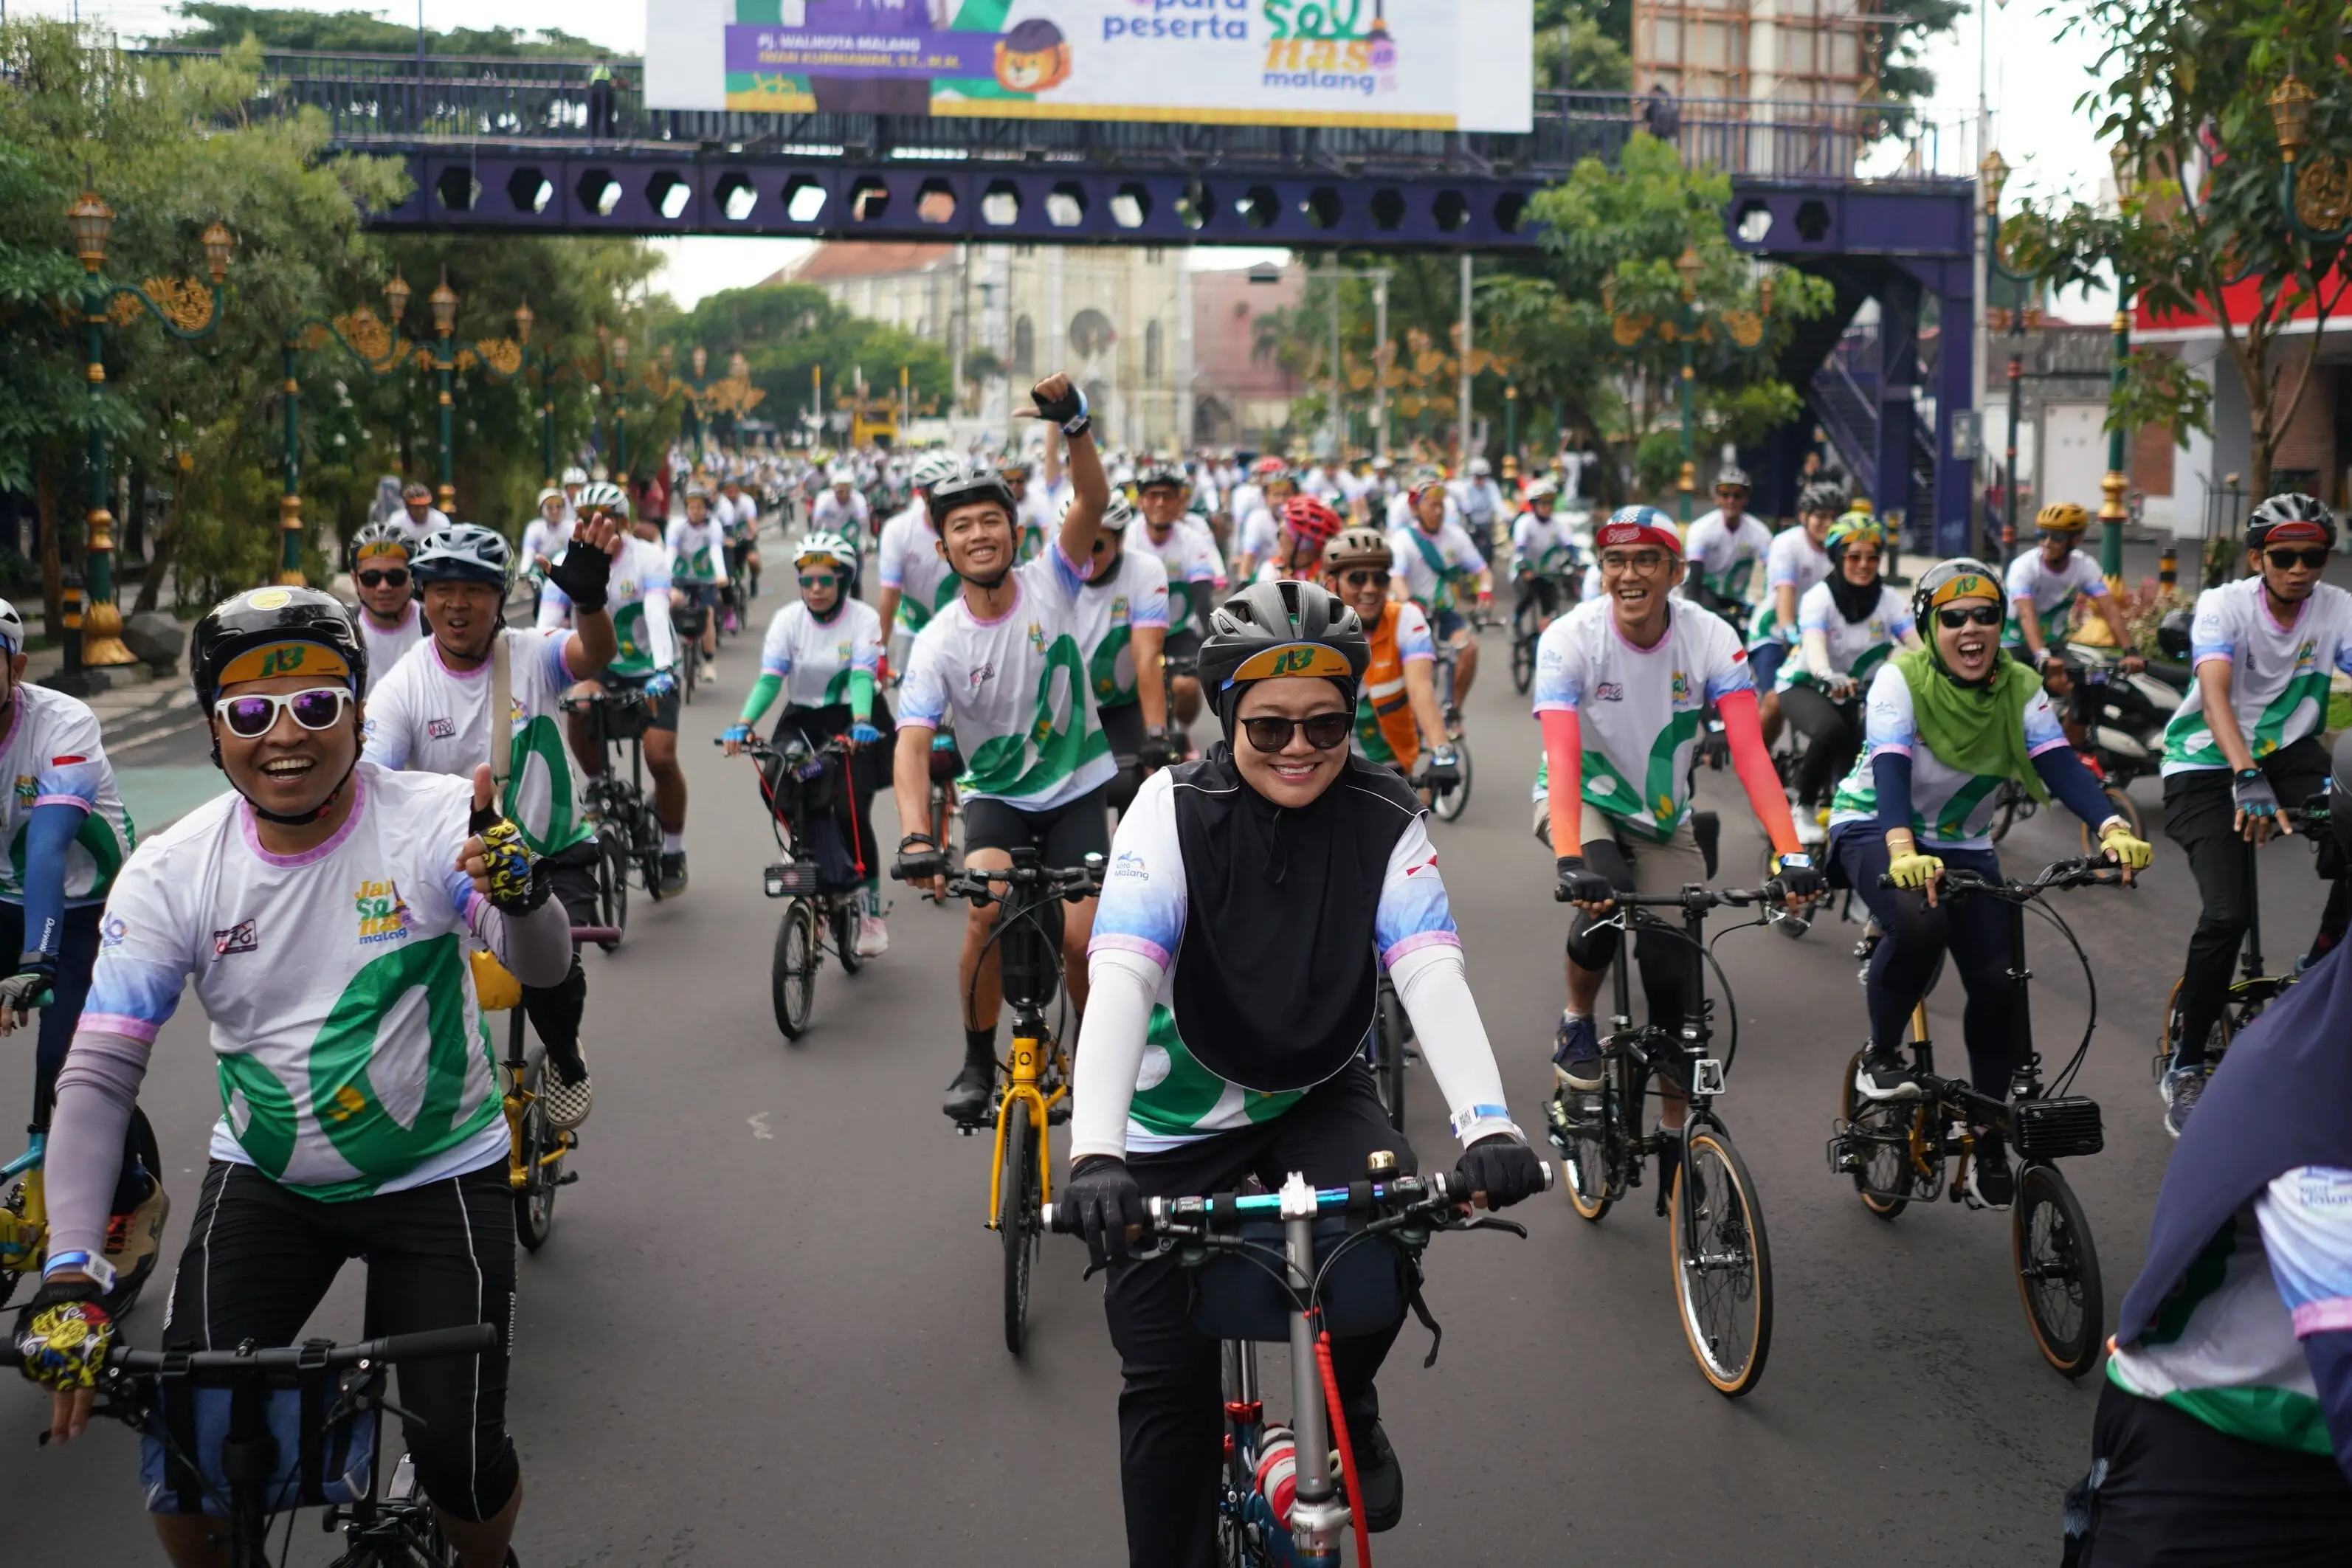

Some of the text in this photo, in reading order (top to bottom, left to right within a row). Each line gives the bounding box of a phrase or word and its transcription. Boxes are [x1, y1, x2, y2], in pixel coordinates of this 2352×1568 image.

[1104, 15, 1247, 42] peserta
[779, 33, 855, 50] WALIKOTA
[857, 36, 920, 52] MALANG
[1265, 39, 1373, 72] nas
[1263, 69, 1374, 97] malang
[1114, 869, 1149, 881] Malang
